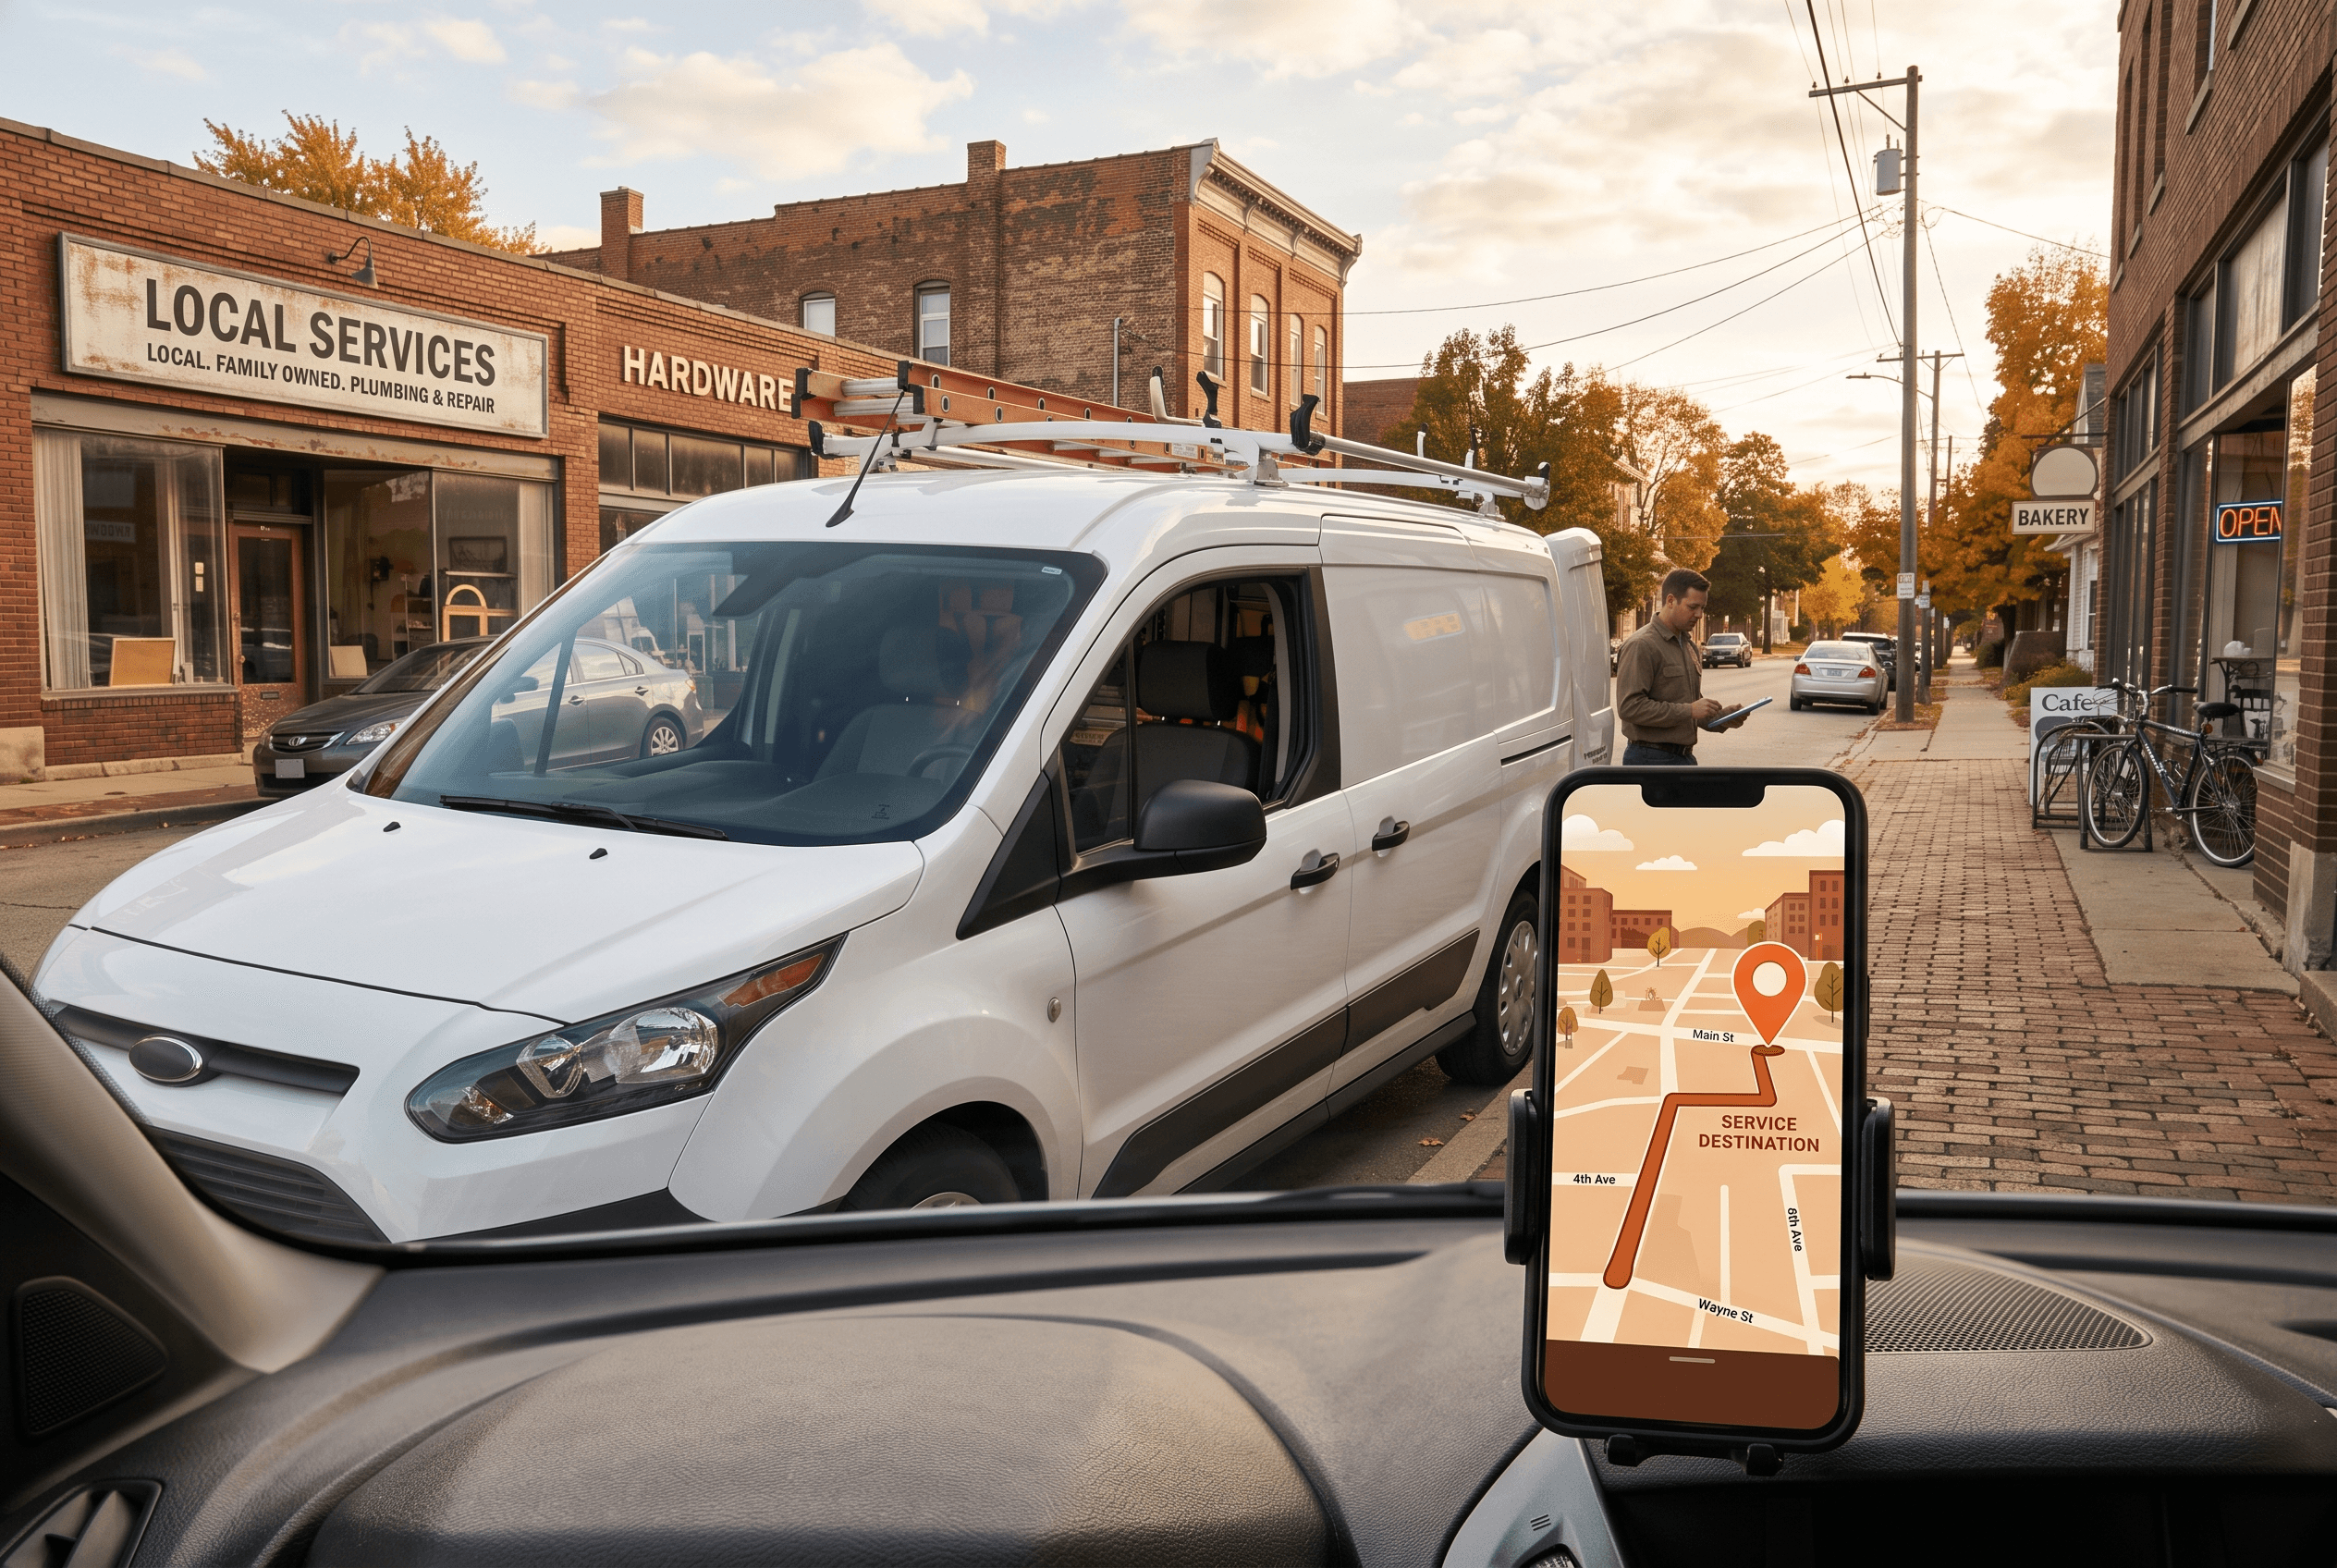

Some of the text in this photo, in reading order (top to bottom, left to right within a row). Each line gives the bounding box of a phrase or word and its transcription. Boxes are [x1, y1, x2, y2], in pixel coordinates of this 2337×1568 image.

[146, 277, 496, 387] LOCAL SERVICES
[147, 342, 496, 414] LOCAL. FAMILY OWNED. PLUMBING & REPAIR
[624, 345, 794, 413] HARDWARE
[2017, 508, 2089, 526] BAKERY
[2041, 692, 2093, 712] Cafe
[1693, 1029, 1734, 1043] Main St
[1721, 1114, 1797, 1131] SERVICE
[1698, 1133, 1819, 1153] DESTINATION
[1572, 1173, 1616, 1184] 4th Ave
[1791, 1230, 1803, 1252] Ave
[1699, 1297, 1754, 1324] Wayne St
